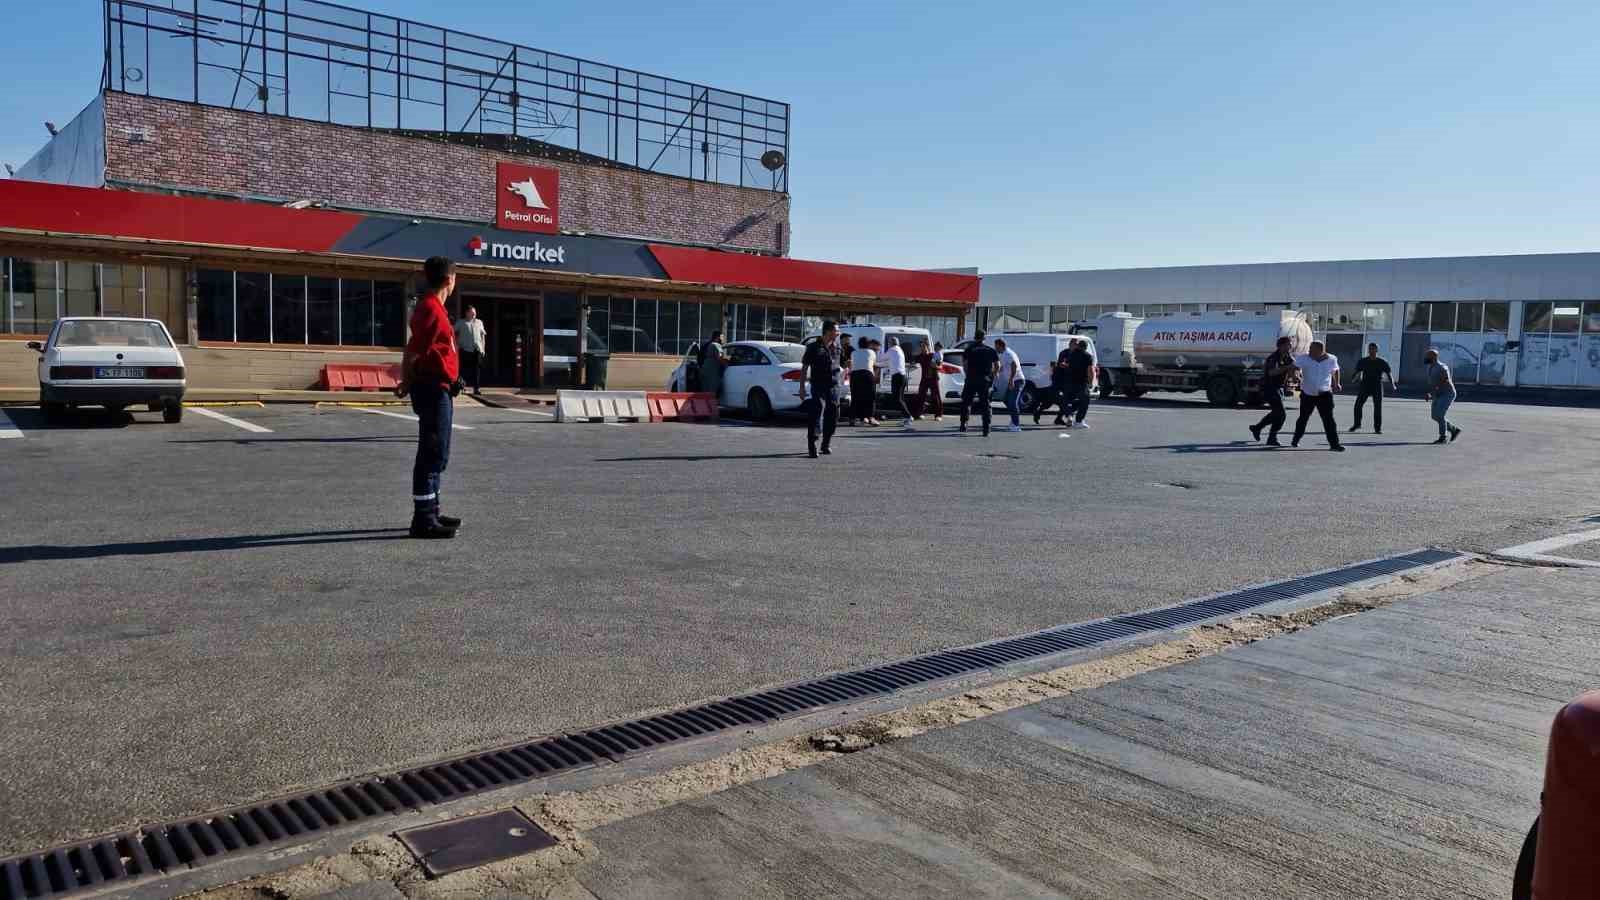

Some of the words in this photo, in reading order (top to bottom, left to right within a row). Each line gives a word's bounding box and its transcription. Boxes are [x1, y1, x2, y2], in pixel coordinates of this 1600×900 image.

[504, 210, 531, 221] Petrol
[532, 214, 553, 224] Ofisi
[491, 241, 565, 263] market
[1154, 331, 1176, 341] ATIK
[1179, 331, 1217, 343] TAŞIMA
[1217, 331, 1252, 342] ARACI
